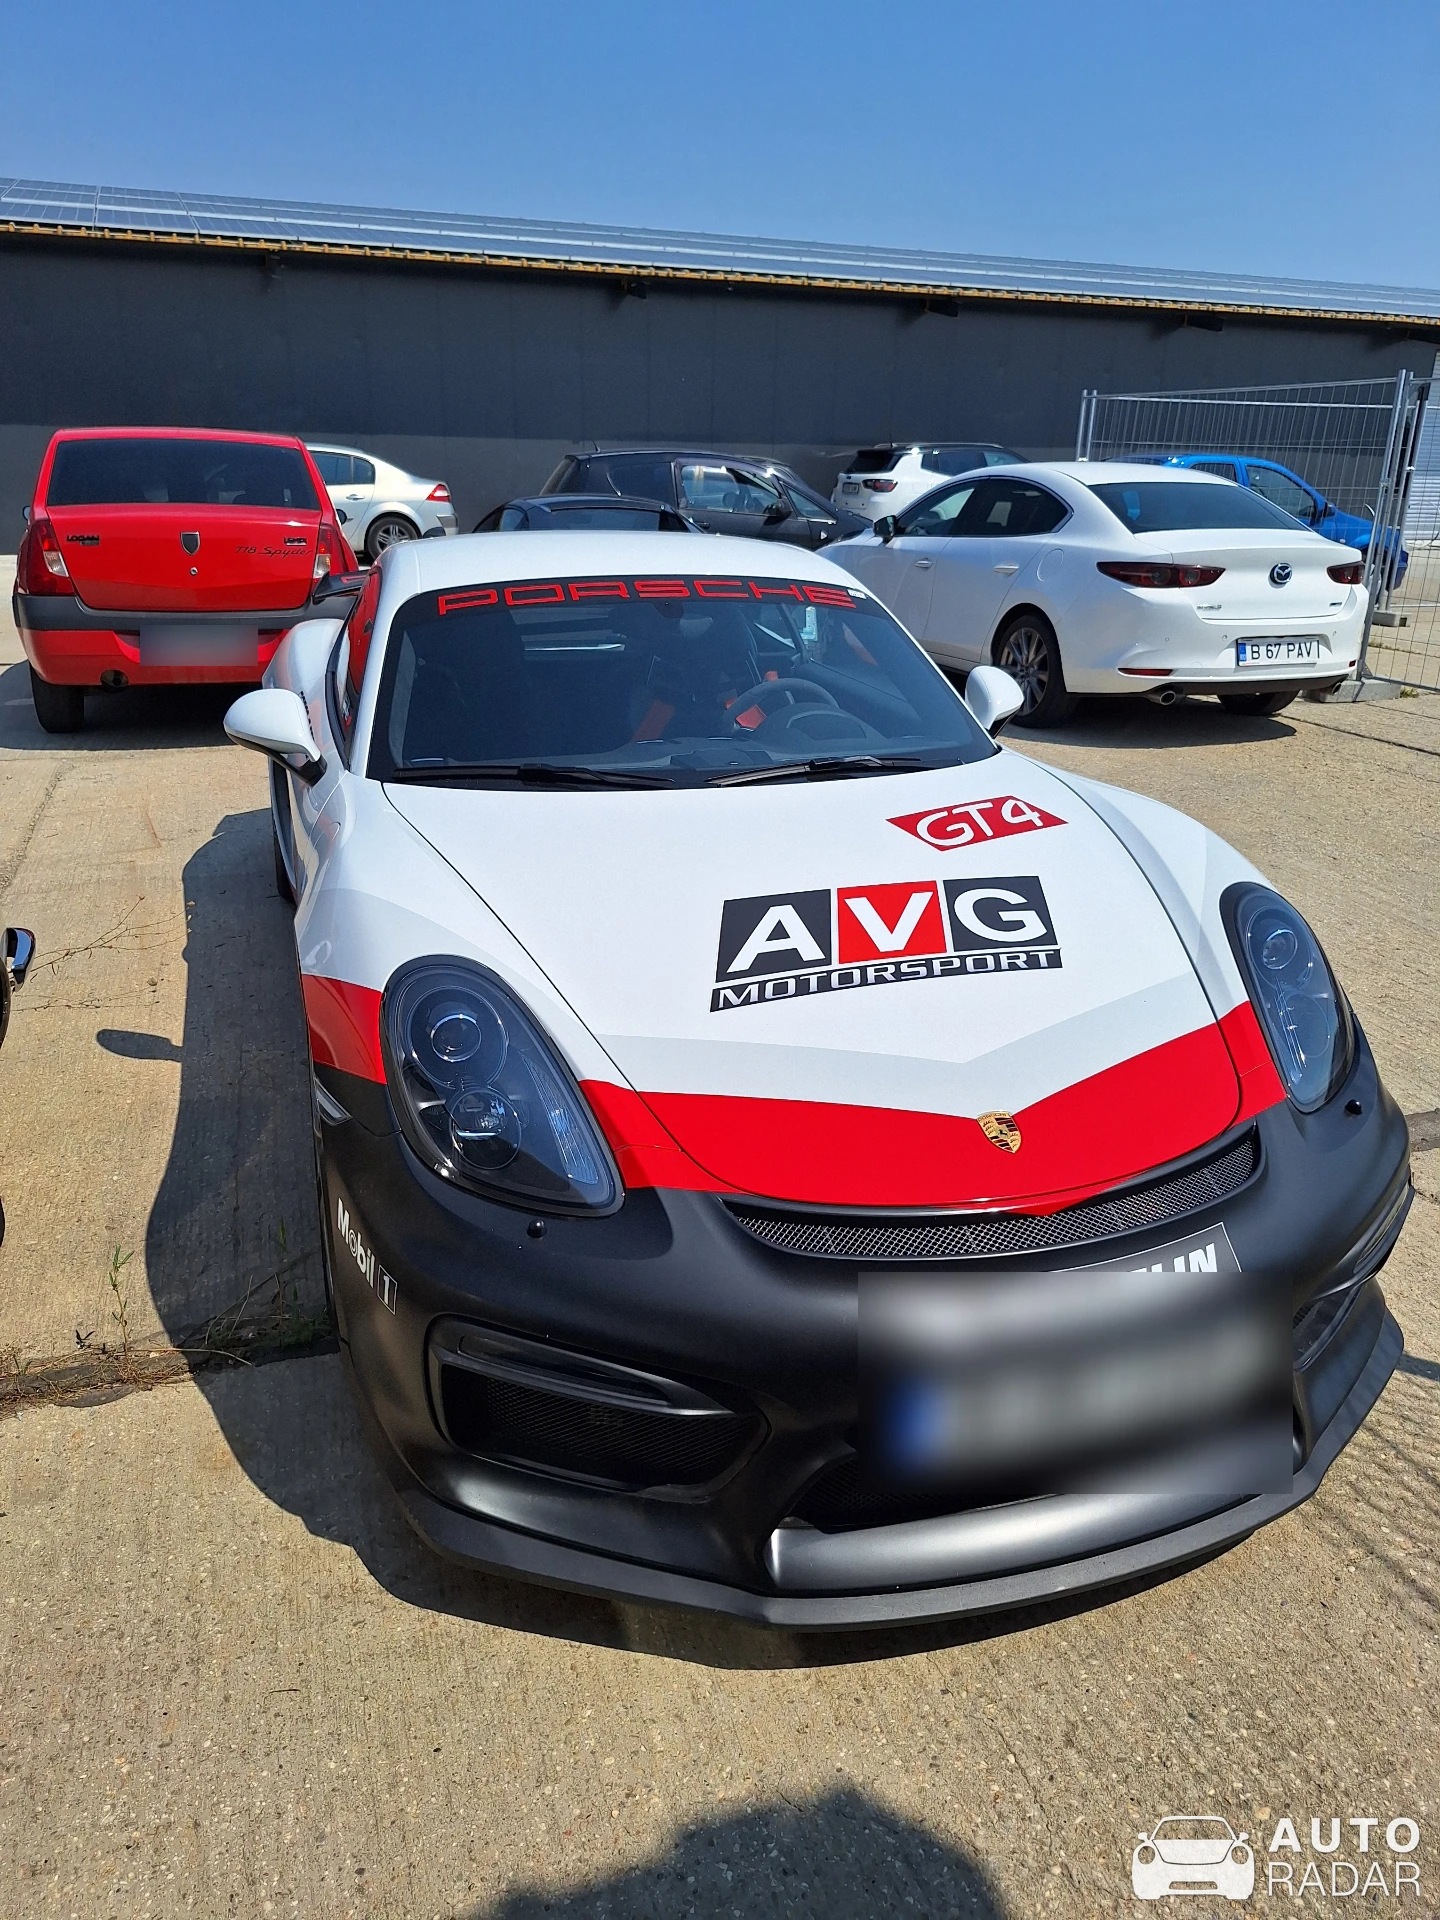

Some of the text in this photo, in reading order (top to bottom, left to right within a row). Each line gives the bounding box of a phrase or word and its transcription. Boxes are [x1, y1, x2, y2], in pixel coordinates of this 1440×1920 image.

[258, 546, 313, 558] Spyder
[438, 579, 857, 616] PORSCHE
[1251, 641, 1313, 660] B 67 PAV
[726, 888, 1048, 974] AVG
[717, 950, 1056, 1009] MOTORSPORT
[337, 1197, 376, 1289] Mobil
